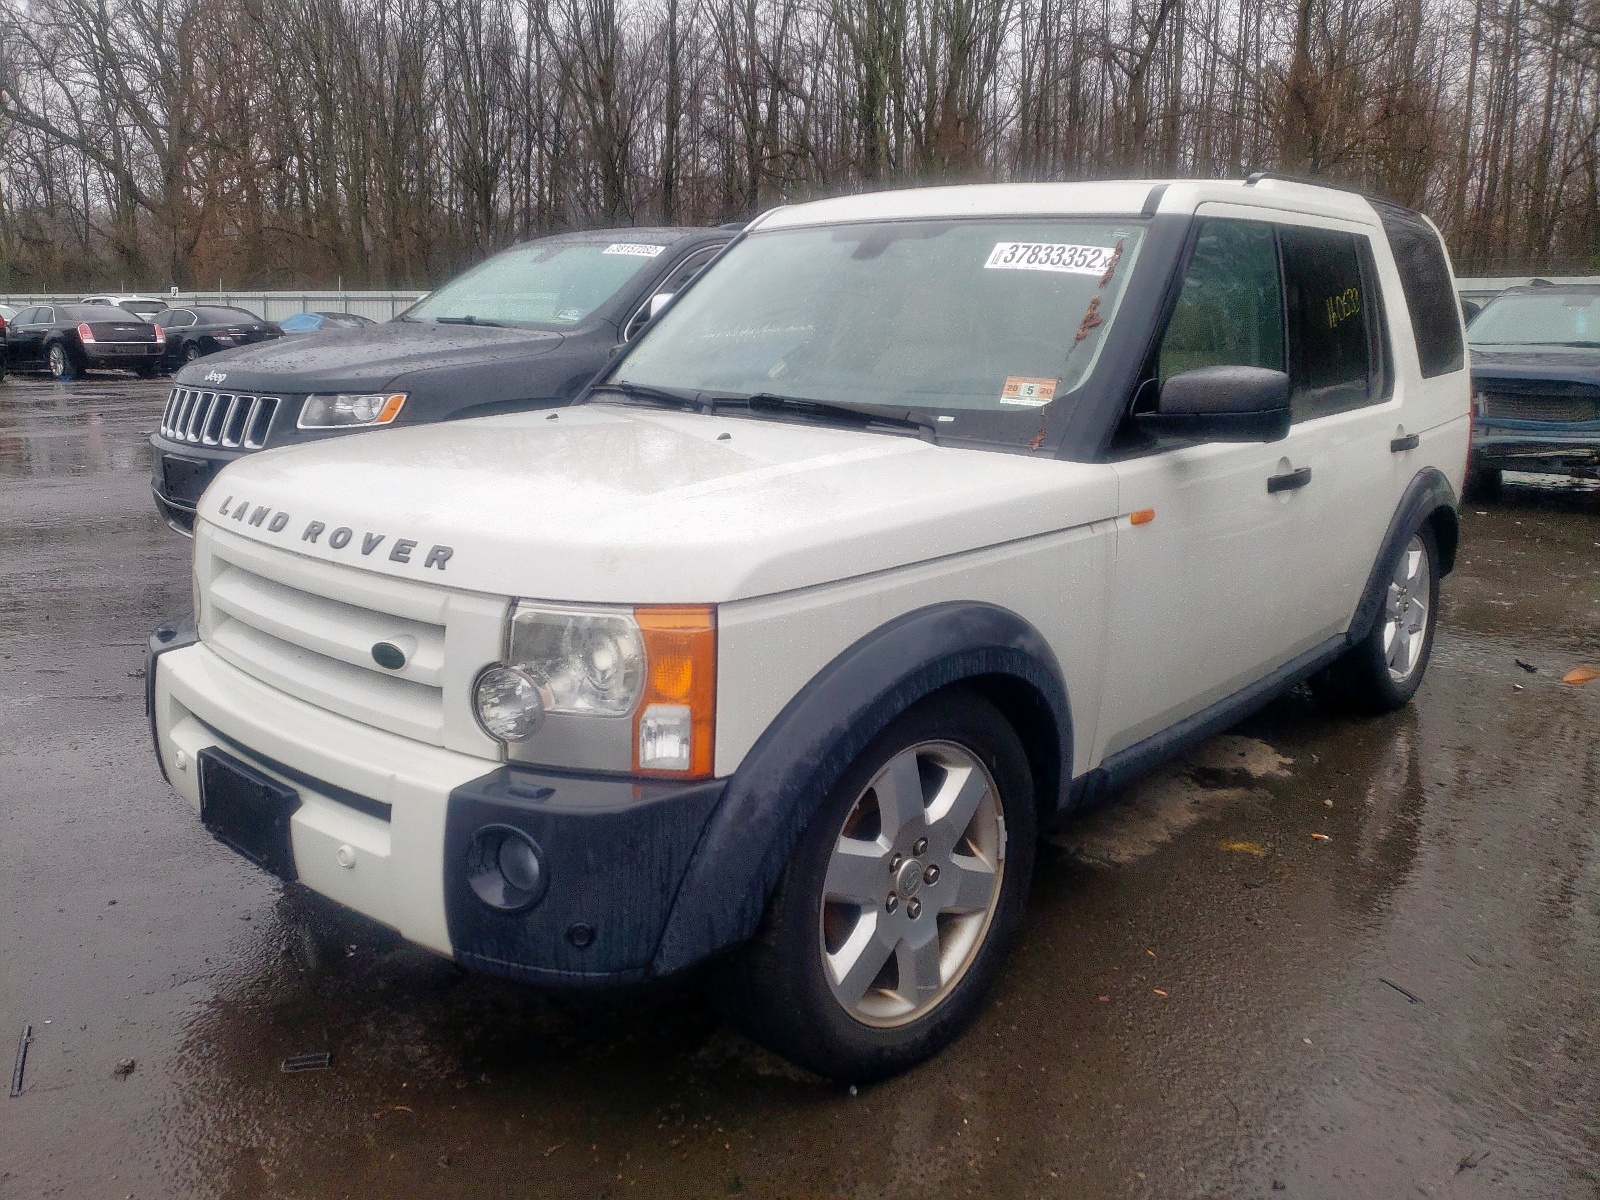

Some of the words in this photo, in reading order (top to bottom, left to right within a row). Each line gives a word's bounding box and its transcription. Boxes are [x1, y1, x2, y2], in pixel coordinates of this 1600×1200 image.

[204, 370, 227, 384] Jeep
[1006, 384, 1019, 392] 20
[1026, 385, 1035, 395] 5
[218, 495, 290, 533] LAND
[301, 520, 454, 571] ROVER
